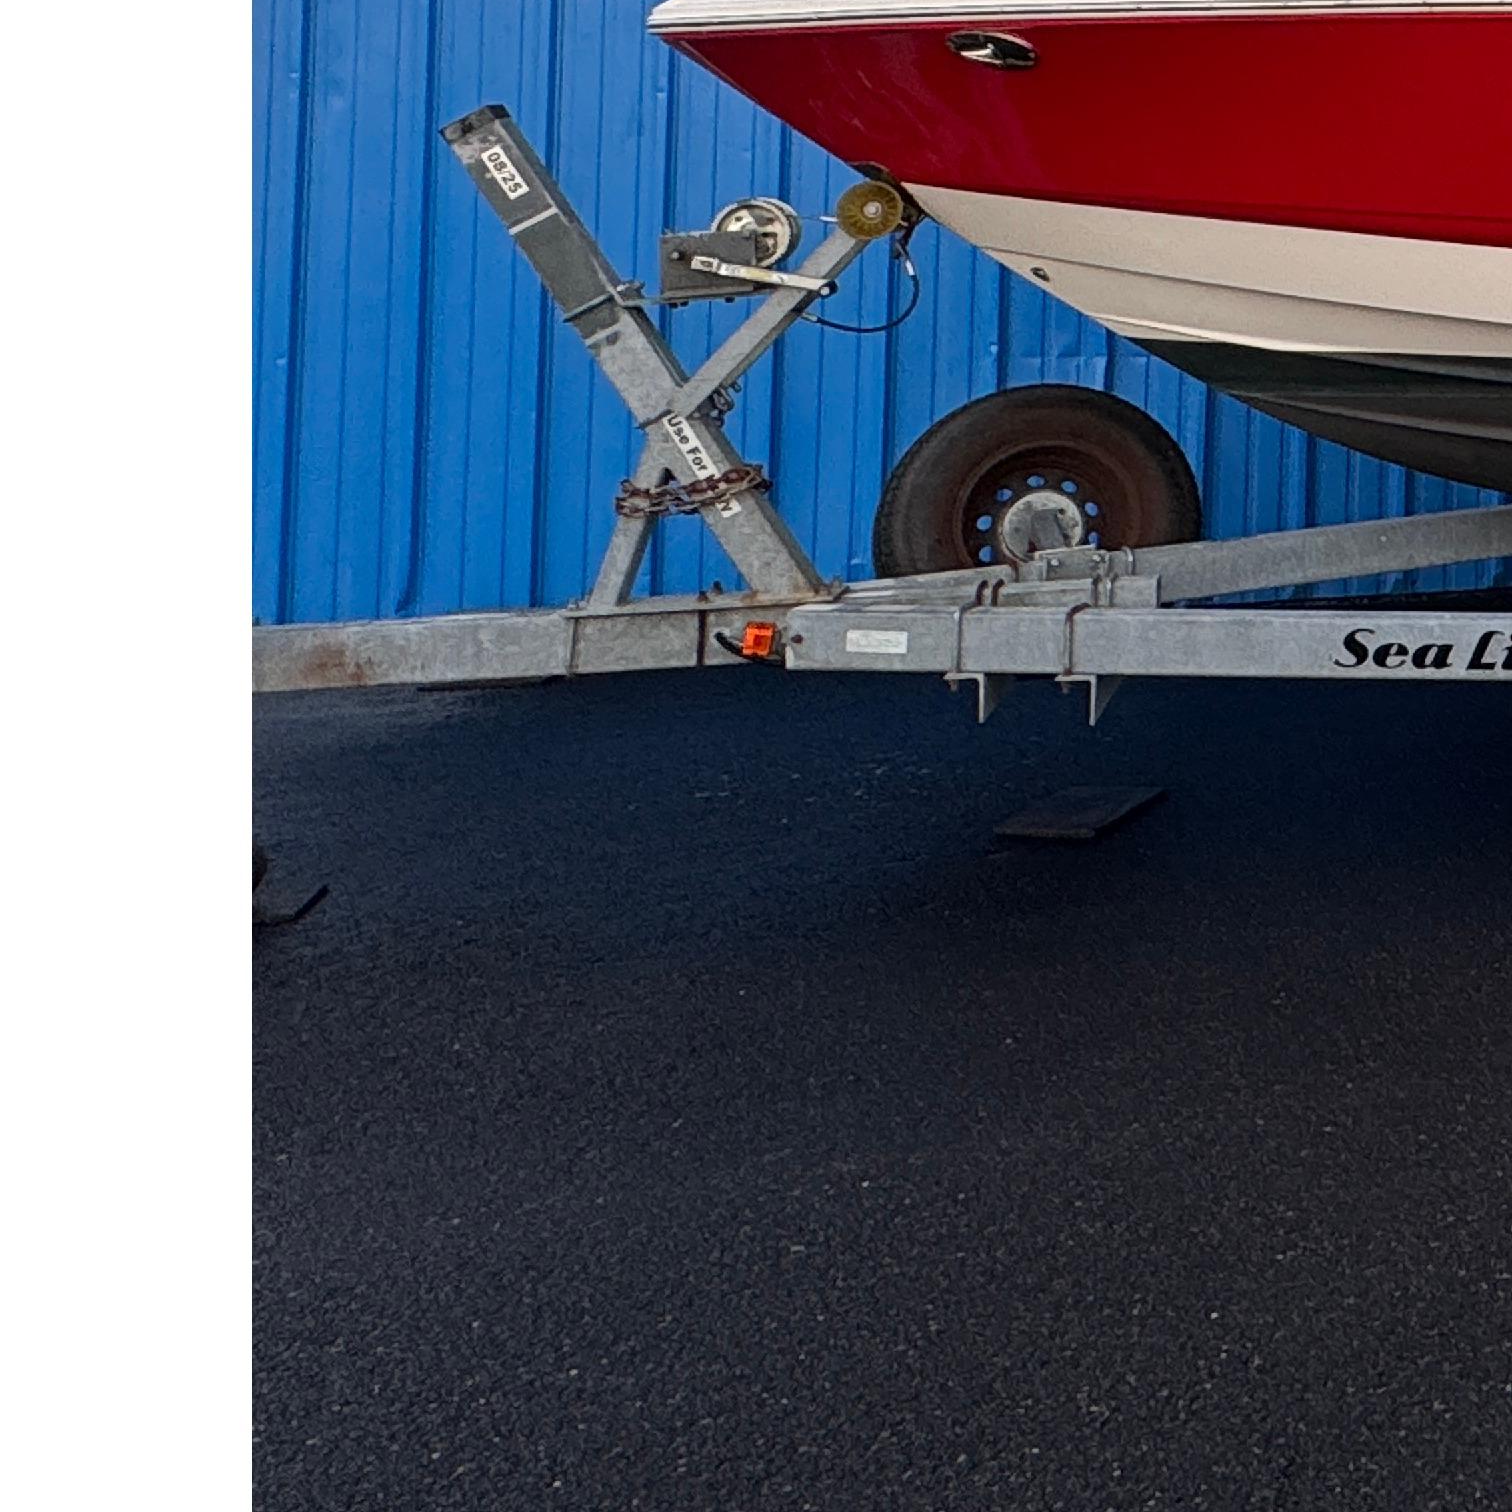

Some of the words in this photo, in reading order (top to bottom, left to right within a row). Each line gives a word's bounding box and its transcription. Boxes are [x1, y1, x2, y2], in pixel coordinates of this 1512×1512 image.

[666, 414, 691, 445] Use
[685, 446, 708, 472] For
[1332, 628, 1454, 670] Sea
